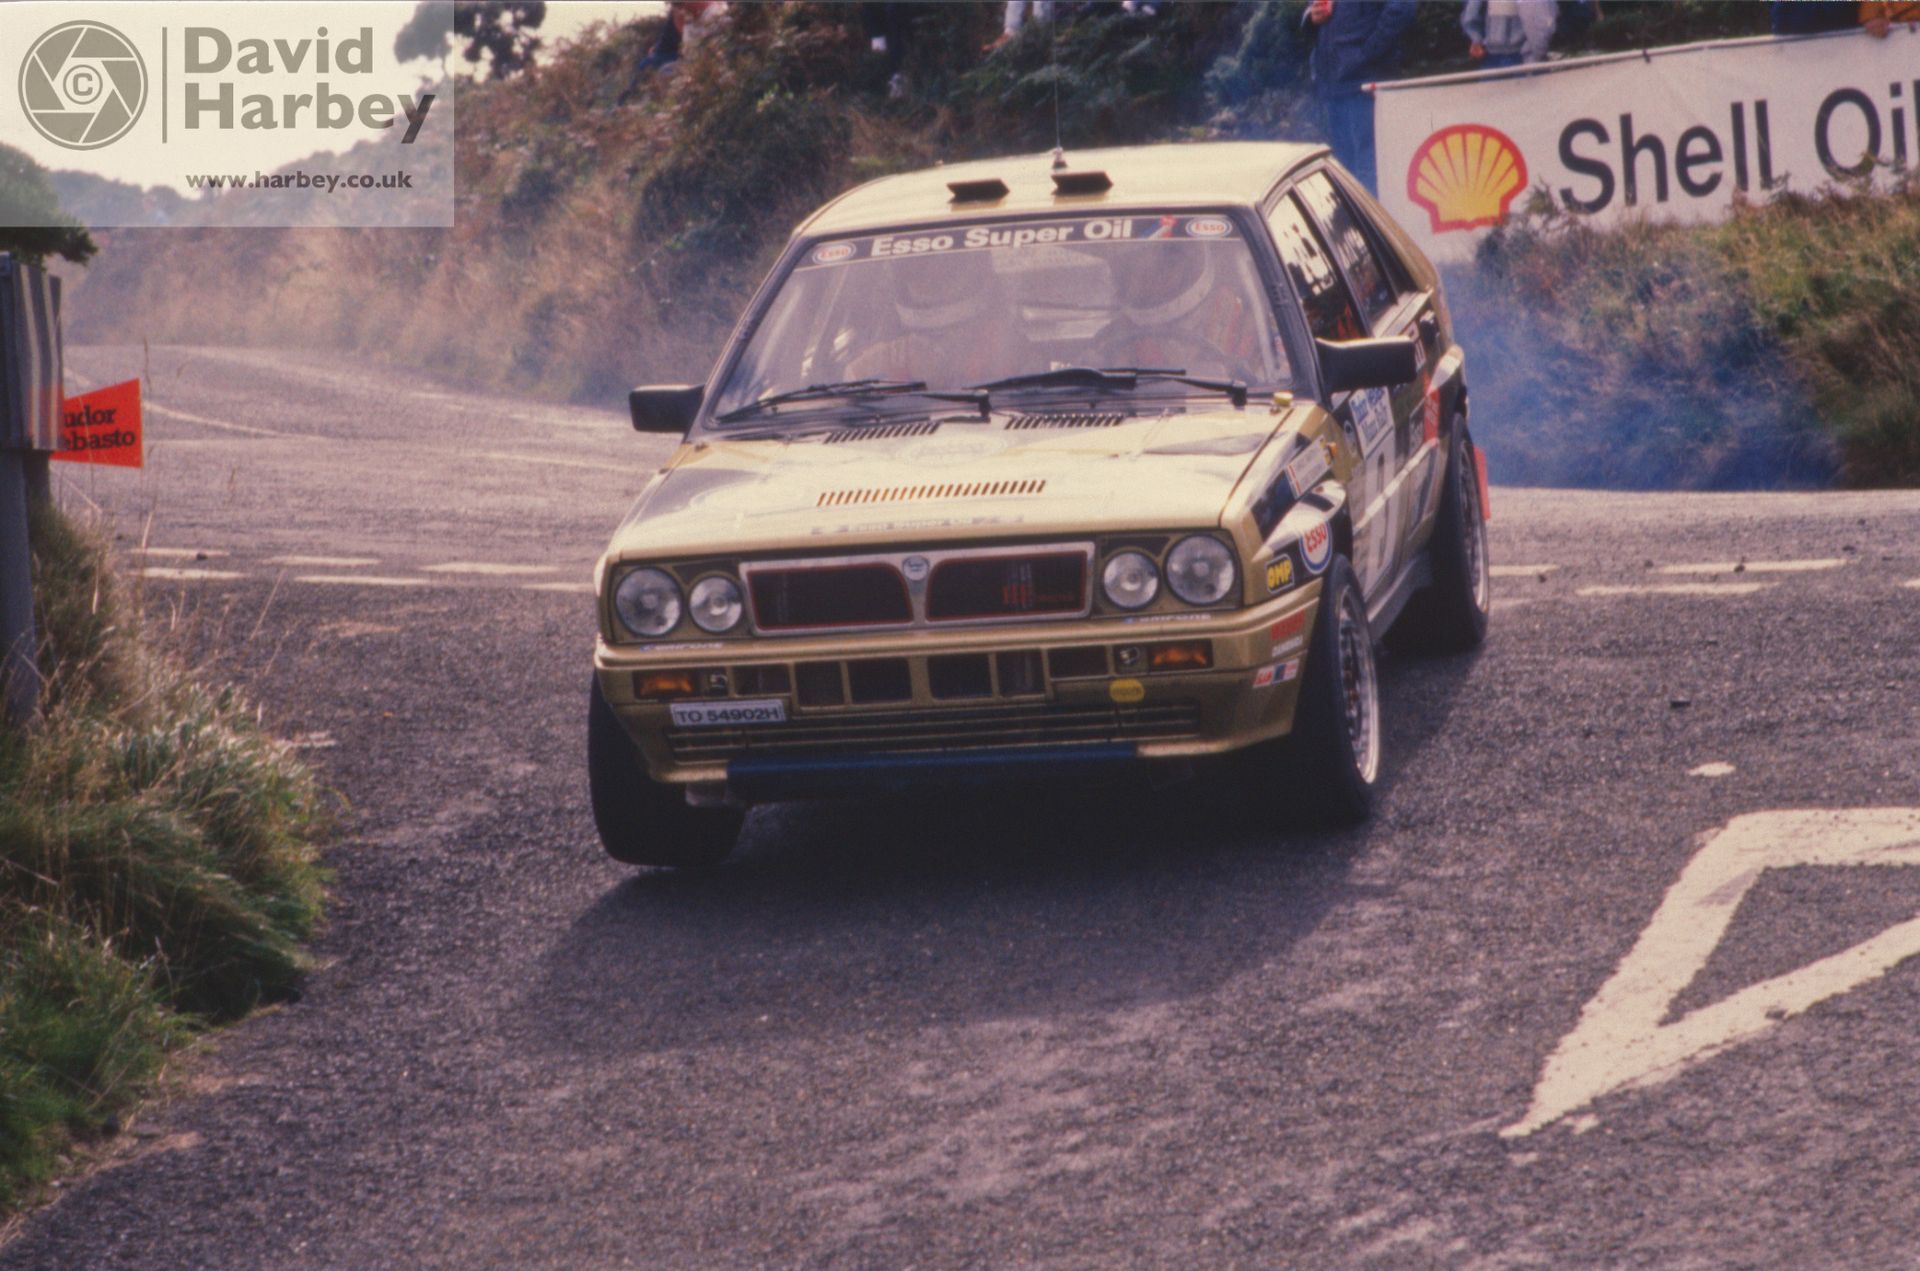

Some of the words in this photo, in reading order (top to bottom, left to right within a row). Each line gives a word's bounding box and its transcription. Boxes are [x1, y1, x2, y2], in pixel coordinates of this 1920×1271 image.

[1558, 99, 1773, 214] Shell
[870, 235, 954, 257] Esso
[964, 226, 1074, 249] Super
[1083, 218, 1133, 240] Oil
[63, 403, 117, 428] udor
[676, 709, 703, 723] TO
[706, 706, 780, 722] 54902H
